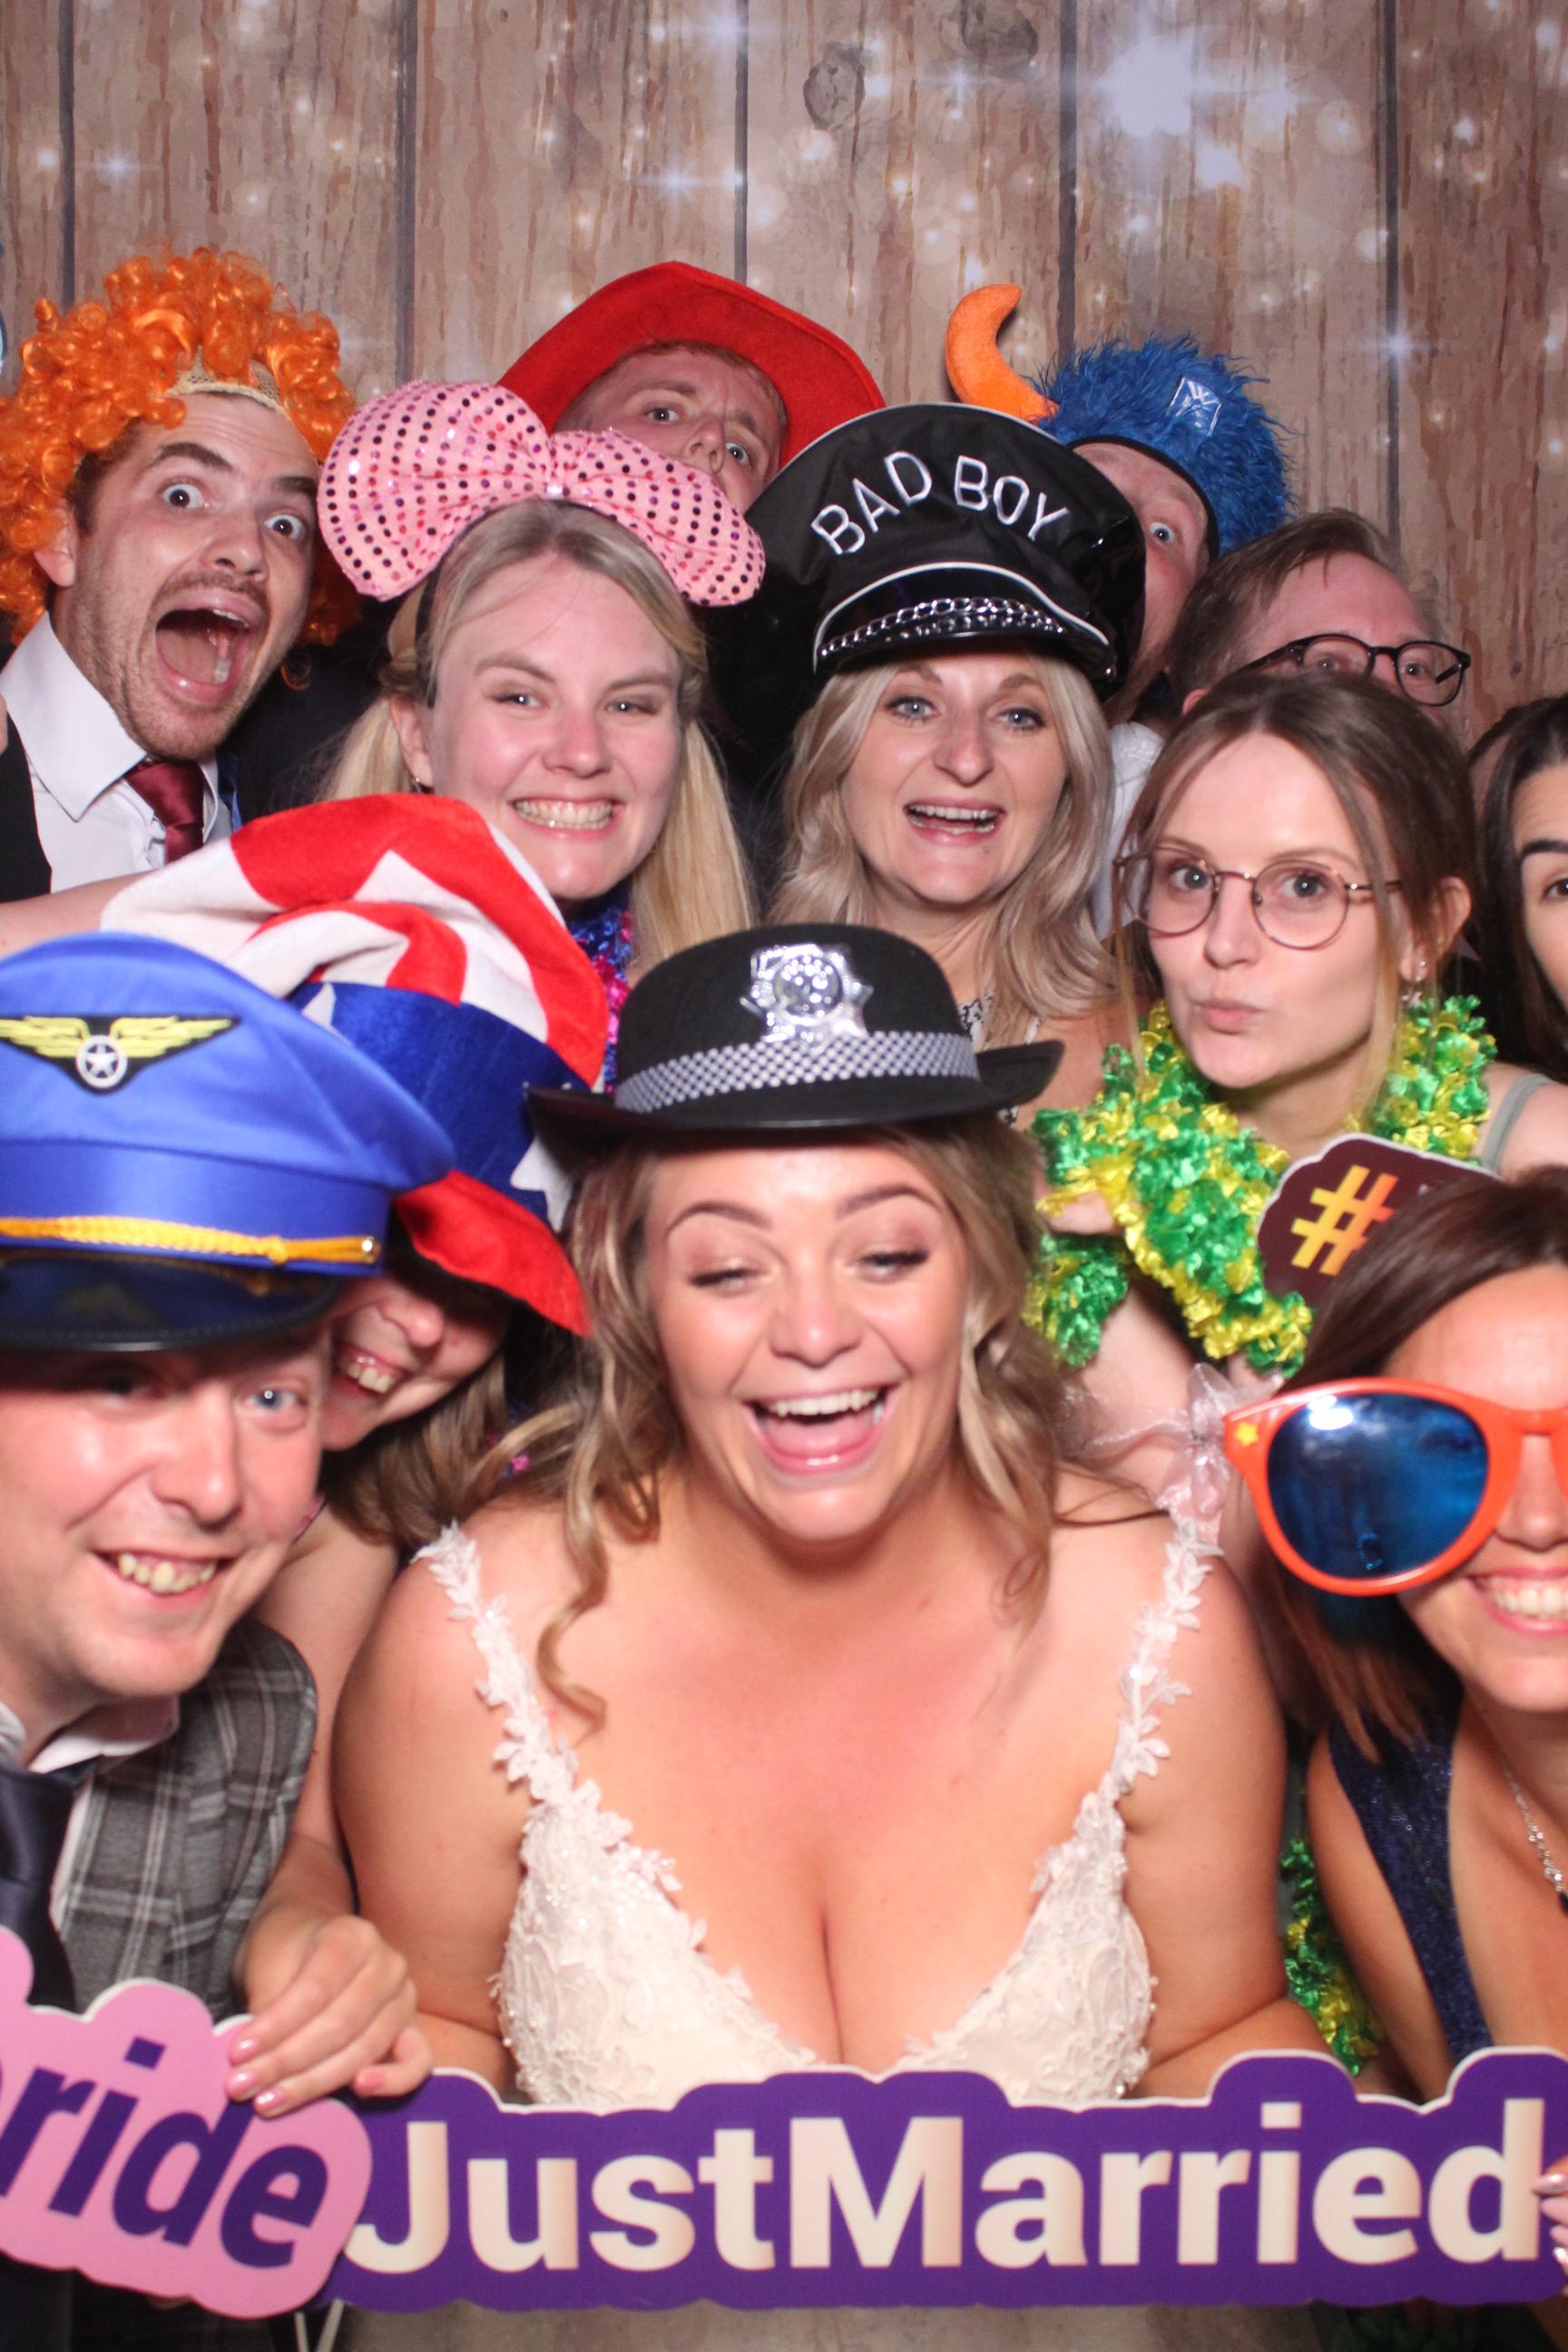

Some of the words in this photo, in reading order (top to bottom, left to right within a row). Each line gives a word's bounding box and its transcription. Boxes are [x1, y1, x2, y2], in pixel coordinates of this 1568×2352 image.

[810, 451, 933, 555] BAD
[954, 455, 1070, 541] BOY
[0, 2036, 328, 2269] ride
